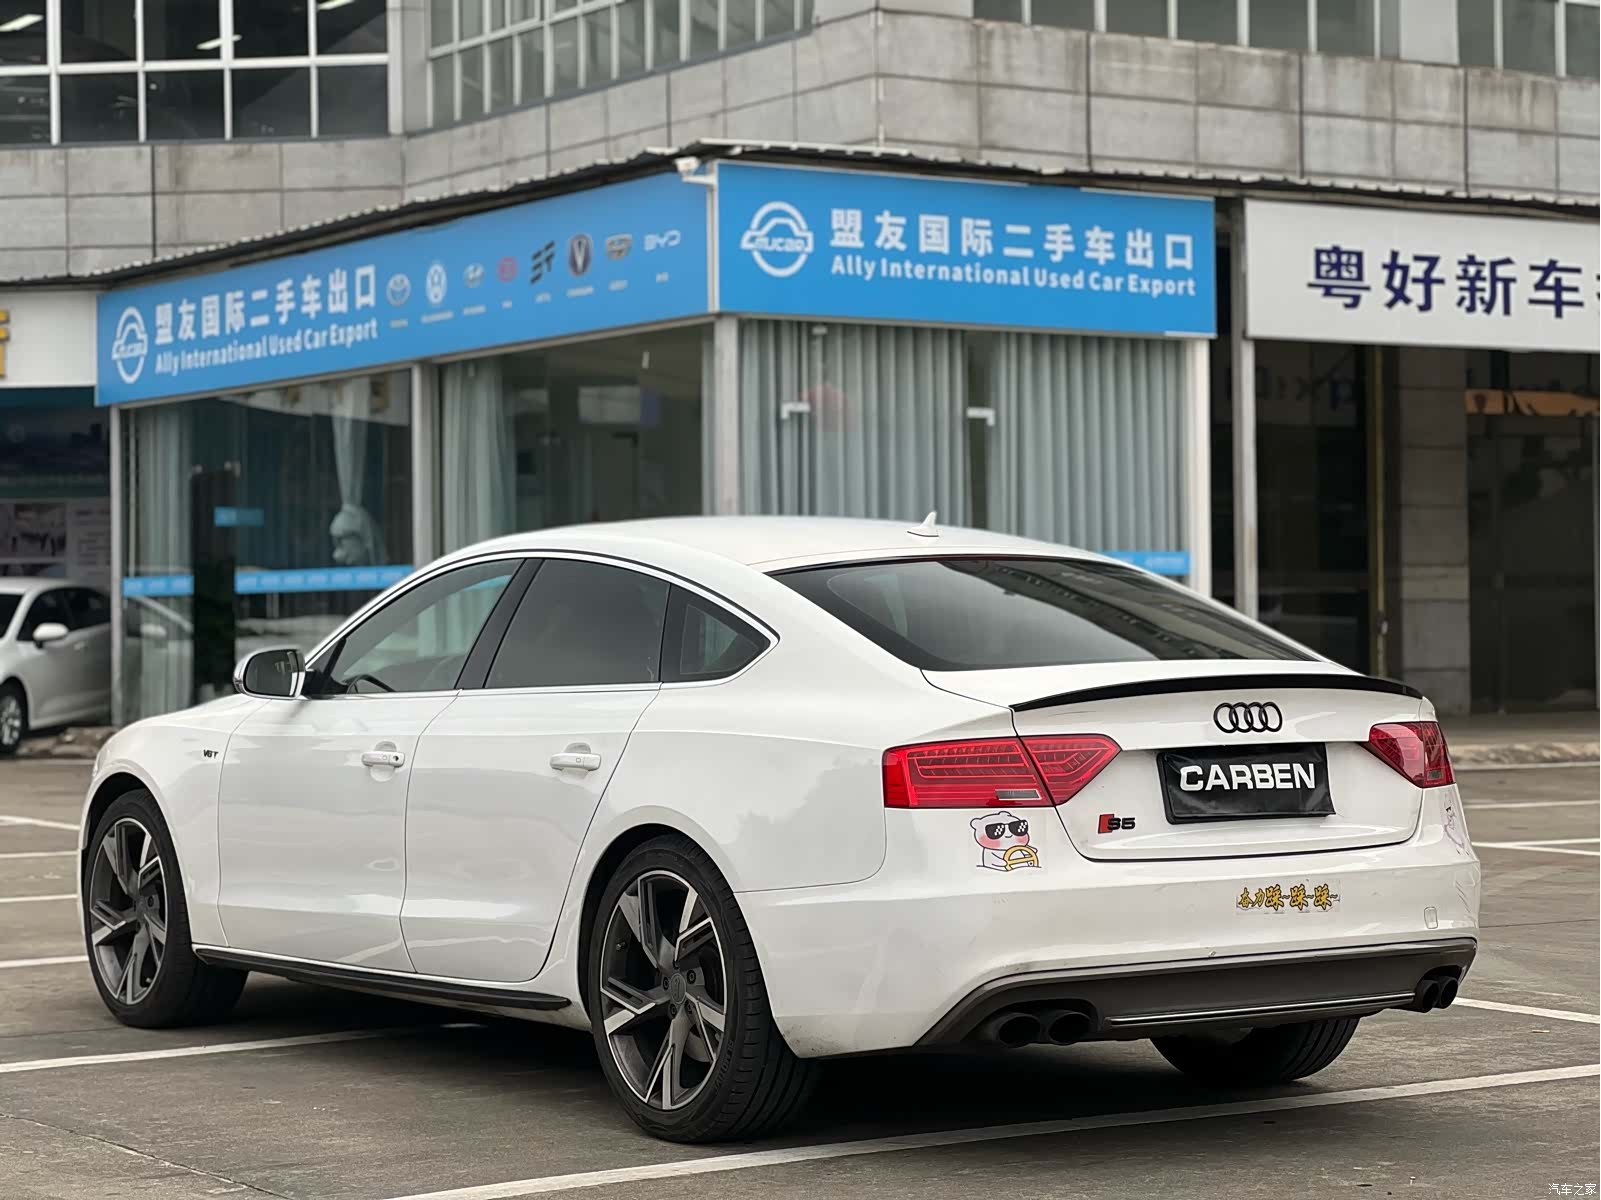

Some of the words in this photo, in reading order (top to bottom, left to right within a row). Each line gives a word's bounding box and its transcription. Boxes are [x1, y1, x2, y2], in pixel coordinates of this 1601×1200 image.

[829, 207, 1193, 271] 盟友国际二手车出口
[154, 264, 377, 346] 盟友国际二手车出口
[831, 253, 876, 281] Ally
[880, 256, 1030, 287] International
[1033, 266, 1085, 290] Used
[1088, 270, 1125, 293] Car
[1127, 272, 1196, 299] Export
[1306, 244, 1600, 319] 粤好新车
[155, 352, 179, 376] Ally
[180, 335, 268, 371] International
[268, 328, 302, 357] Used
[303, 327, 328, 351] Car
[329, 318, 378, 348] Export
[1180, 763, 1316, 791] CARBEN
[1106, 816, 1136, 831] S5
